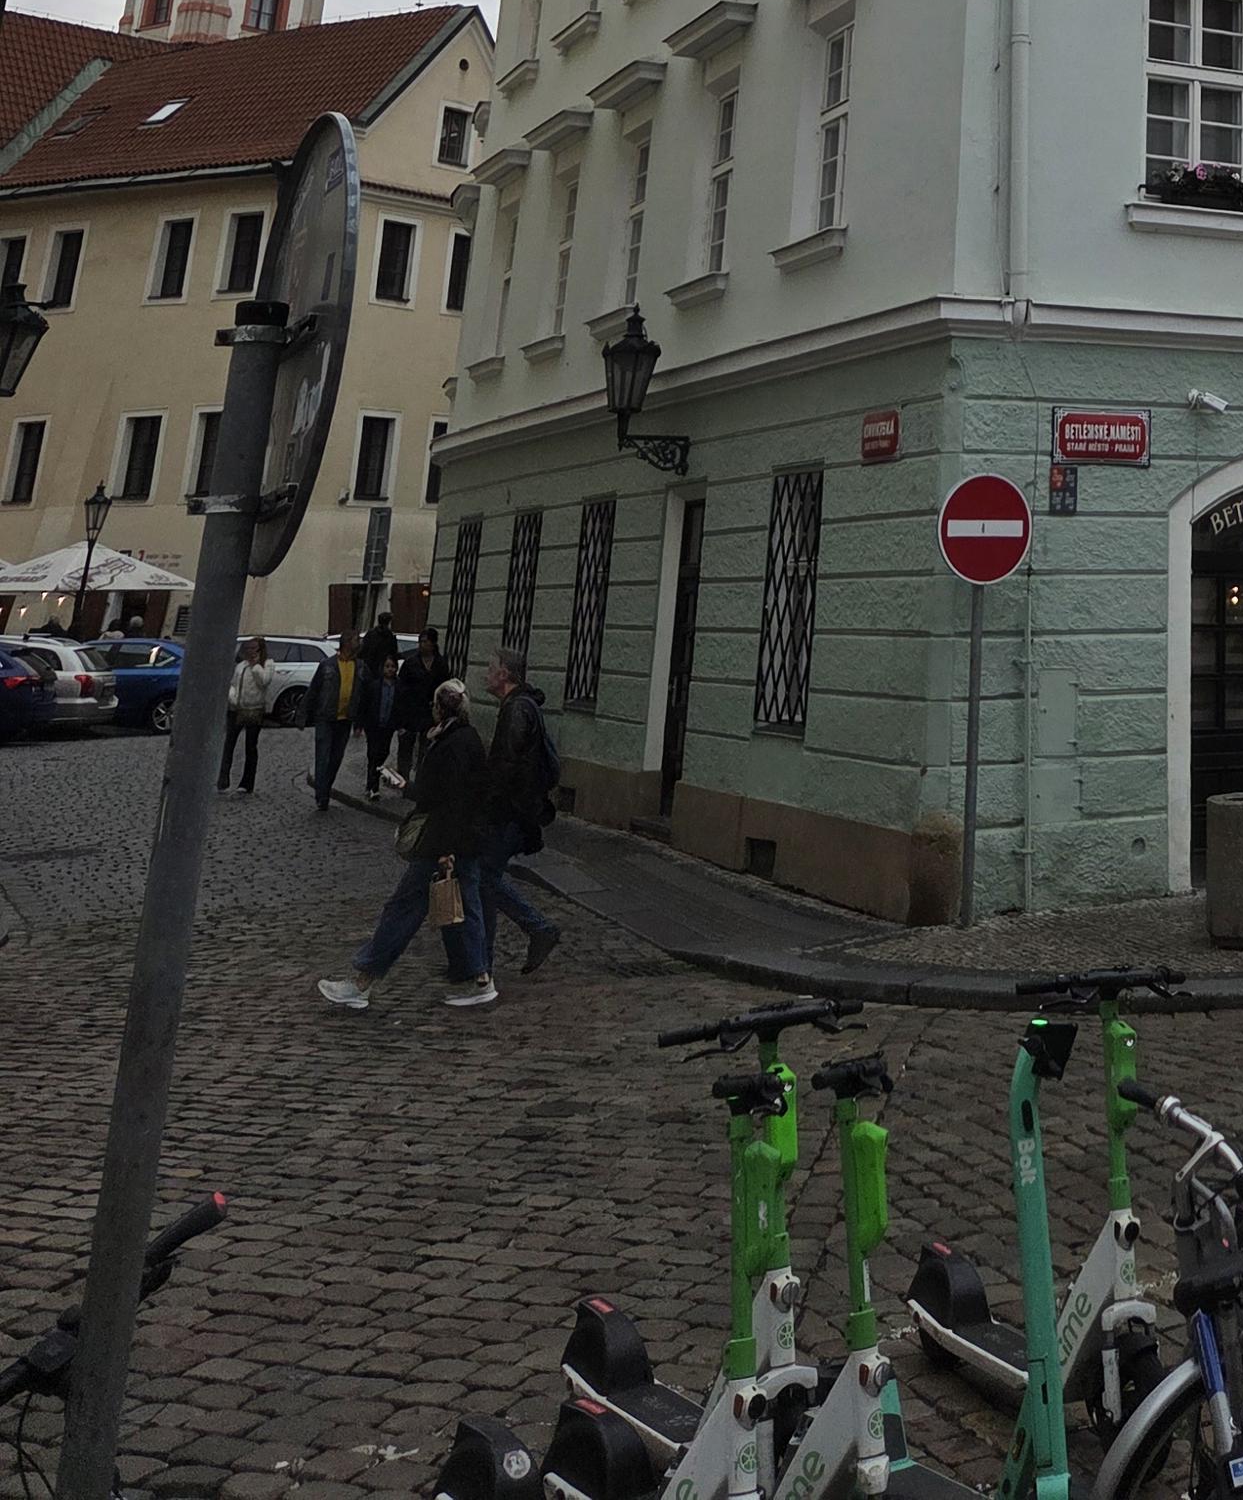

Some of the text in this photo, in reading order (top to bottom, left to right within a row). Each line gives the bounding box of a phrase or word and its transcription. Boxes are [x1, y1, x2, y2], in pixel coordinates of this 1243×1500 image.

[1064, 421, 1142, 441] BETLÉMSKÉ NÁMĚSTÍ
[1066, 441, 1087, 451] STARÉ
[1114, 443, 1135, 452] PRAHA
[1017, 1137, 1037, 1186] Bolt
